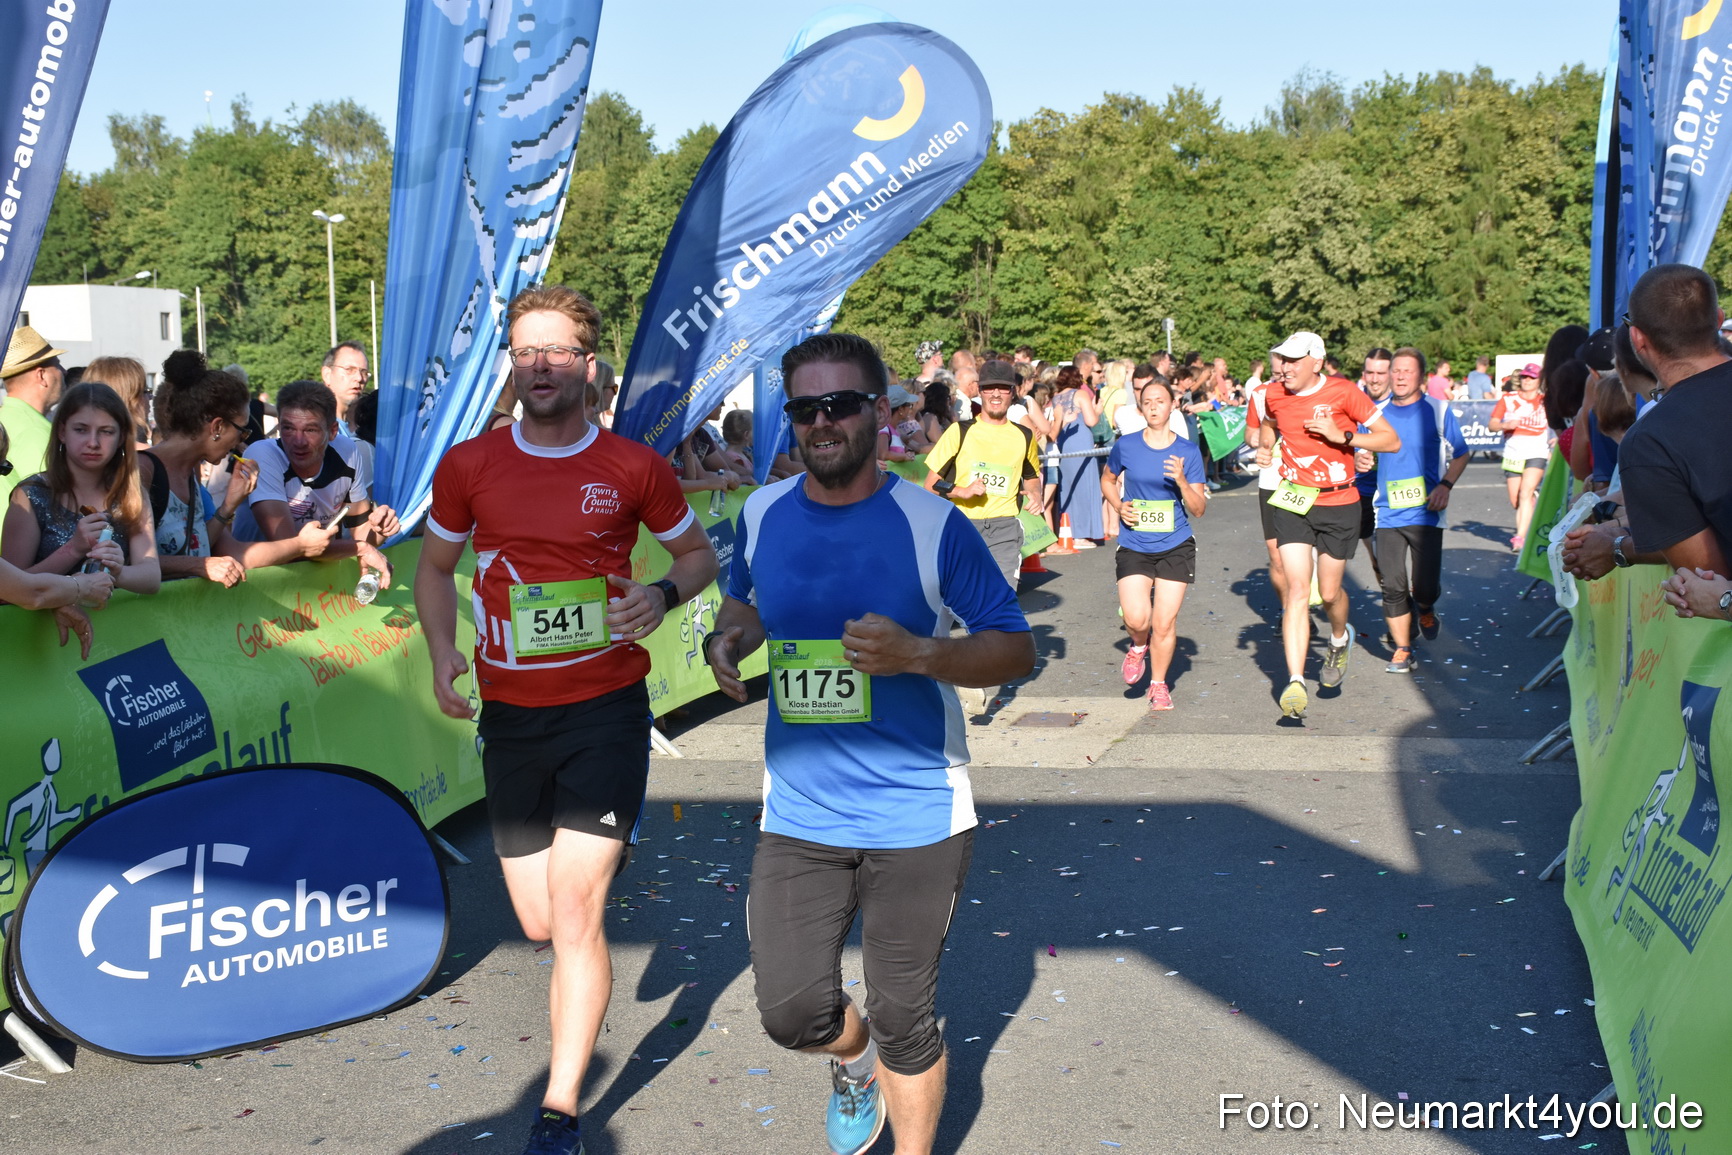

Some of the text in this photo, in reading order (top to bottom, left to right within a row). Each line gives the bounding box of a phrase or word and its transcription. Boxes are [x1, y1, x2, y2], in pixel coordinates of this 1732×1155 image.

[1690, 110, 1723, 177] Druck
[809, 119, 969, 258] Druck und Medien
[662, 151, 885, 350] Frischmann
[644, 338, 749, 446] frischmann-net.de
[580, 483, 619, 499] Town &
[974, 472, 1006, 488] 1632
[1391, 487, 1421, 501] 1169
[581, 495, 622, 514] Country
[594, 507, 614, 515] HAUS
[1282, 491, 1306, 507] 546
[1140, 511, 1165, 523] 658
[236, 592, 320, 659] Gesunde
[533, 605, 585, 635] 541
[530, 630, 593, 643] Albert Hans Peter
[300, 639, 369, 688] laufen
[120, 680, 182, 718] Fischer
[779, 669, 855, 699] 1175
[137, 698, 187, 728] AUTOMOBILE
[788, 700, 843, 708] Klose Bastian
[149, 878, 398, 959] Fischer
[180, 927, 388, 988] AUTOMOBILE
